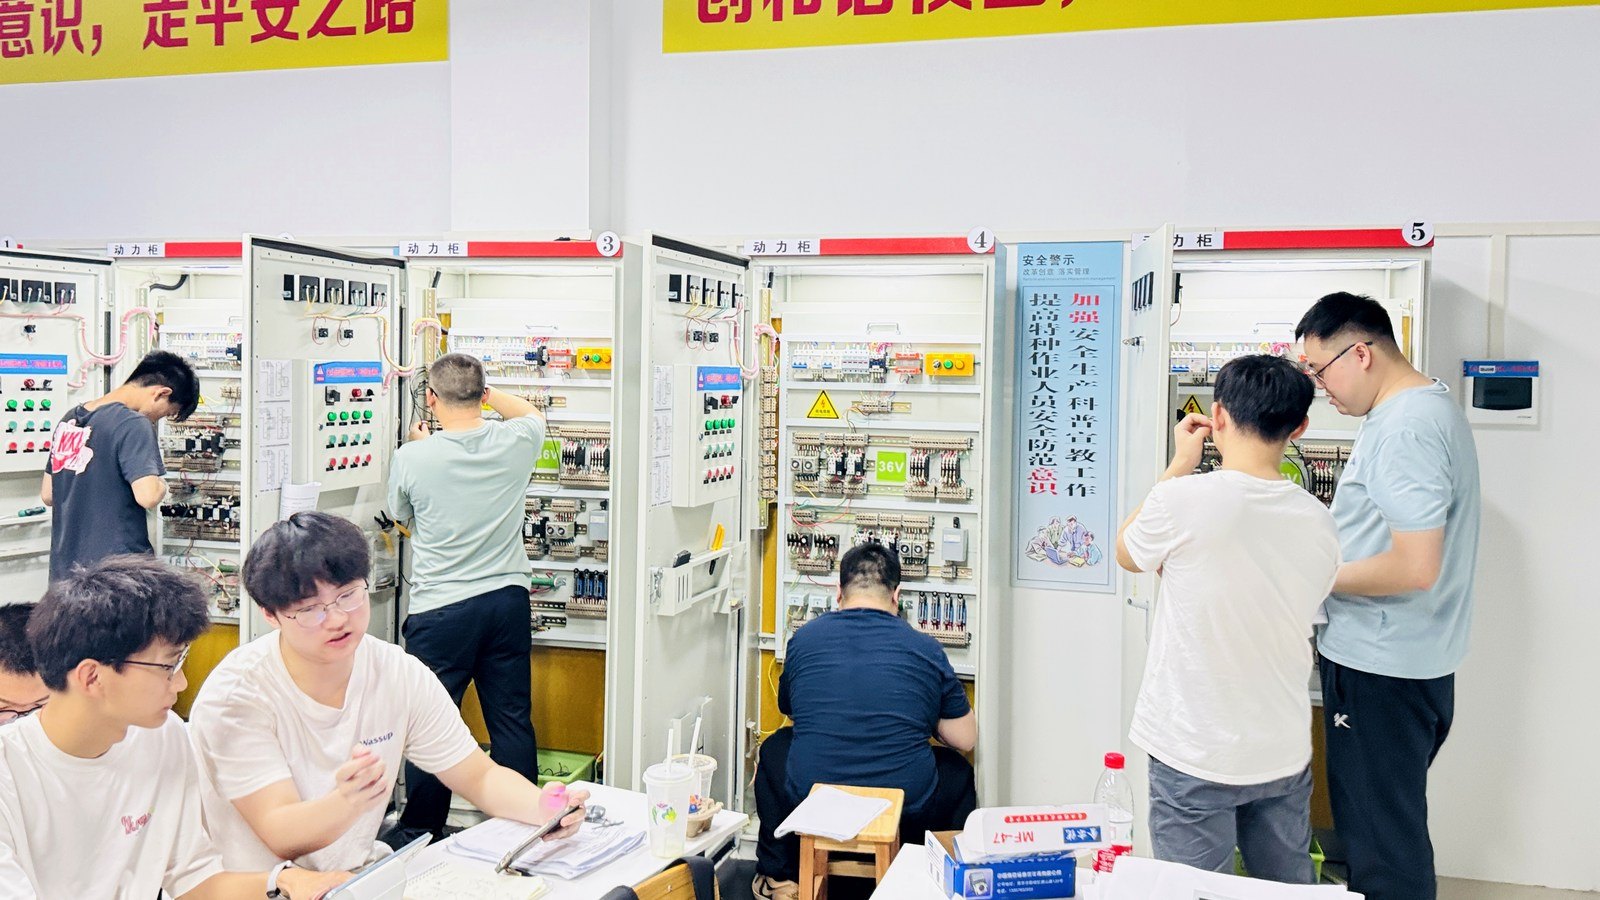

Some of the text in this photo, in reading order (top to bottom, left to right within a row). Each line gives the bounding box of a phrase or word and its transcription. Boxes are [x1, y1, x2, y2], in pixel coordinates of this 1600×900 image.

[1411, 222, 1426, 241] 5
[602, 235, 614, 252] 3
[974, 231, 988, 248] 4
[114, 244, 158, 255] 动力柜
[408, 243, 459, 255] 动力柜
[753, 240, 811, 254] 动力柜
[1022, 254, 1075, 266] 安全警示
[1027, 293, 1062, 496] 提高特种作业人员安全防范意识
[1065, 293, 1100, 498] 加强安全生产科普宣教工作
[878, 460, 905, 473] 36V
[993, 830, 1035, 844] MF-47
